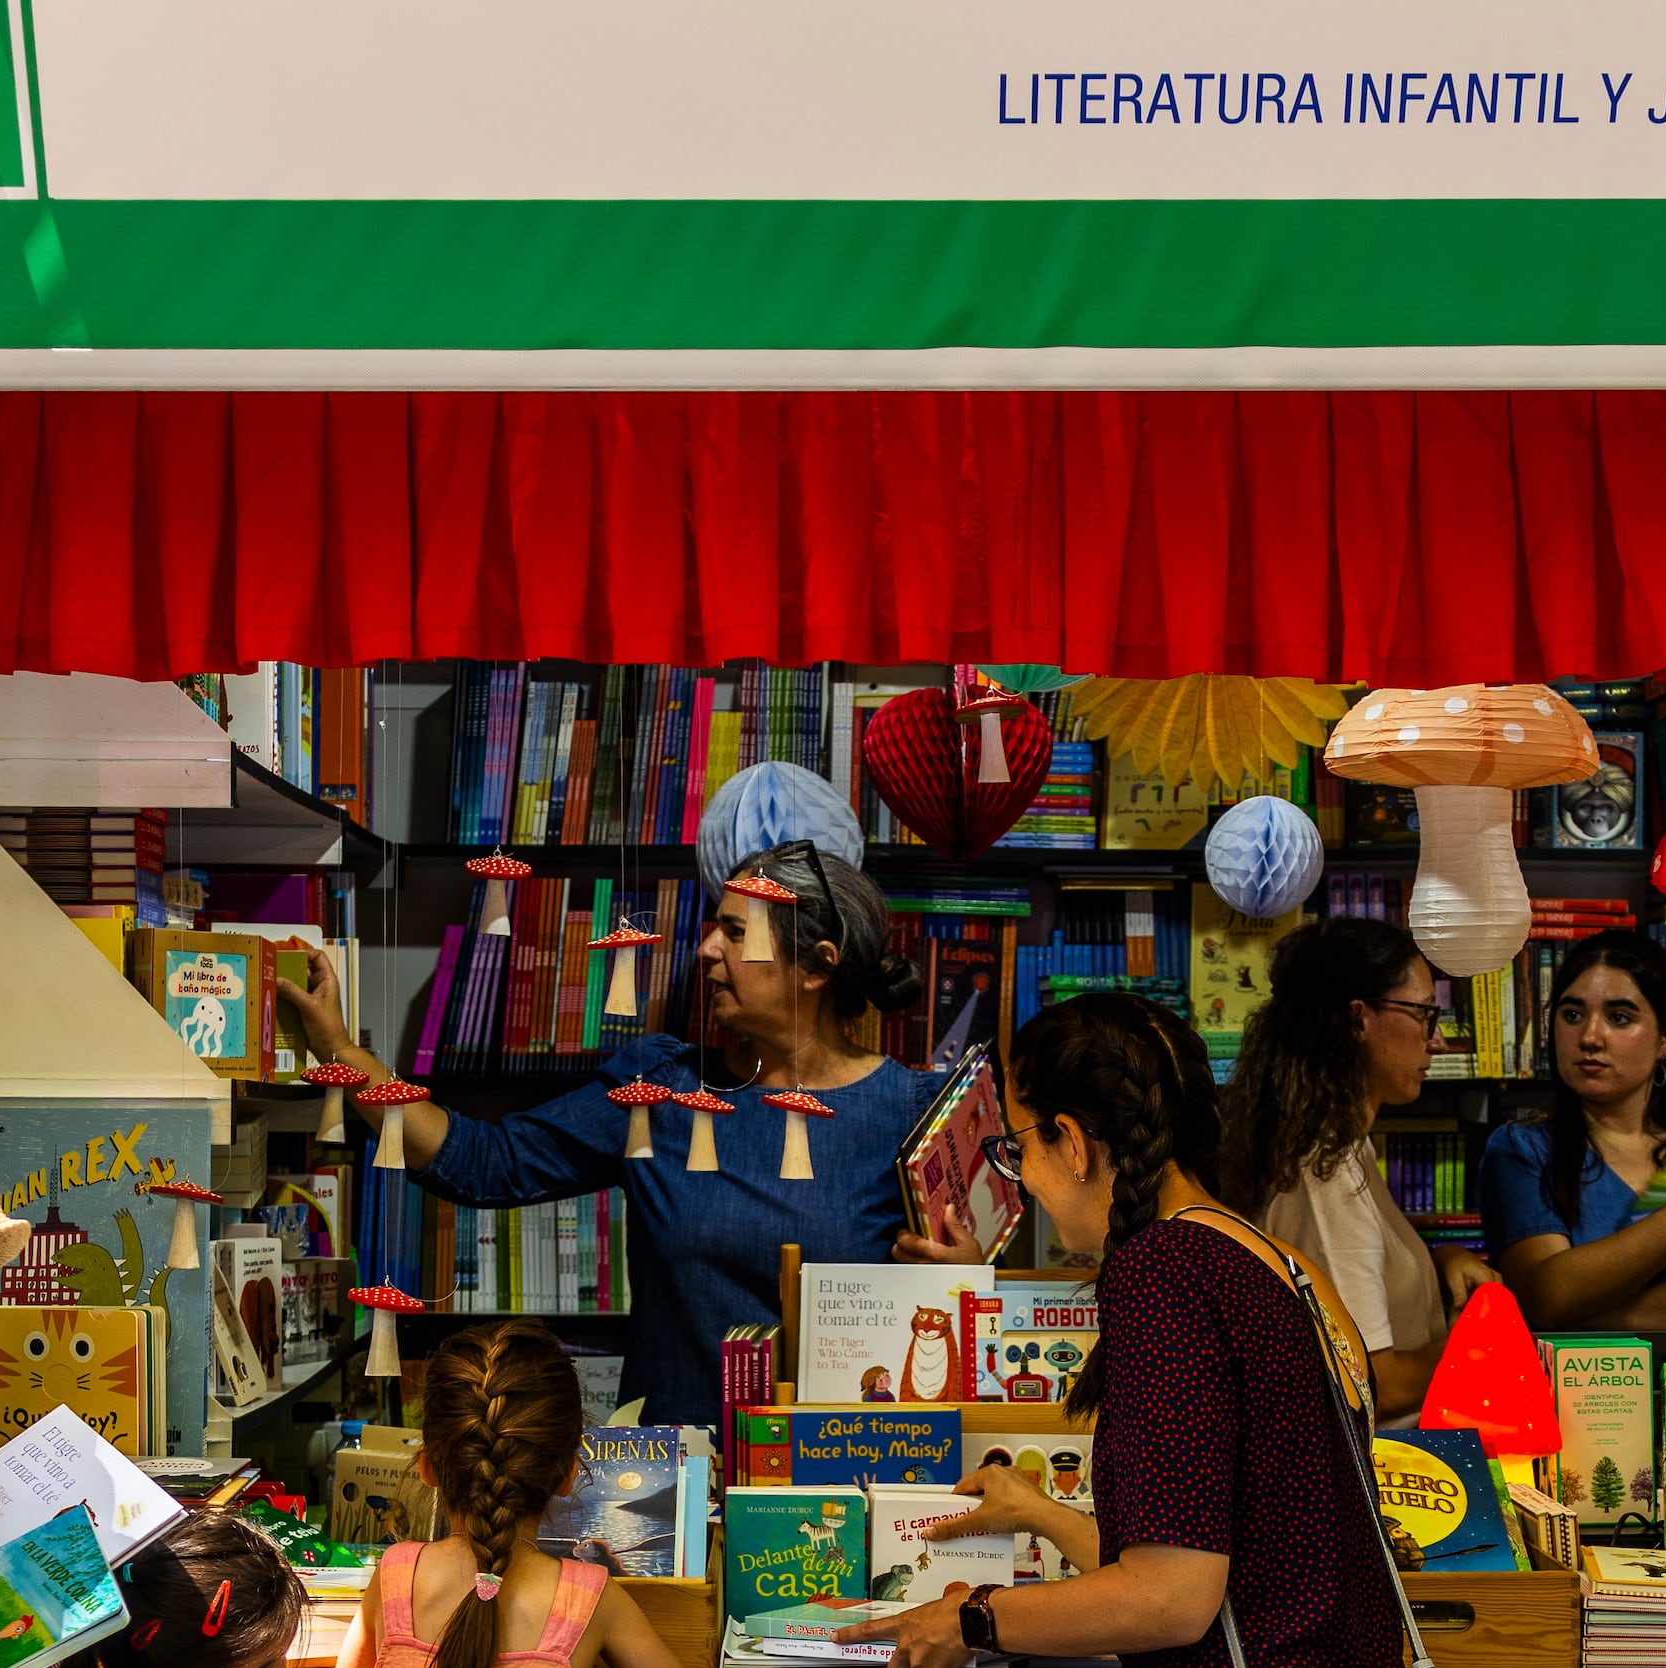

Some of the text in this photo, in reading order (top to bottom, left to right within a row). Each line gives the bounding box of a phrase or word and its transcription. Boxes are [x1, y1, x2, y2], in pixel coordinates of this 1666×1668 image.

[997, 73, 1324, 125] LITERATURA
[1342, 73, 1580, 125] INFANTIL
[1601, 73, 1638, 125] Y
[942, 946, 996, 964] Eclipses
[183, 971, 227, 982] Mi libro de
[178, 983, 232, 995] baño mágico
[59, 1123, 148, 1192] REX
[313, 1272, 338, 1285] PITO
[819, 1280, 871, 1298] El tigre
[818, 1295, 894, 1312] que vino a
[1033, 1297, 1041, 1305] Mi
[1043, 1297, 1074, 1307] primer
[818, 1312, 898, 1326] tomar el té
[818, 1337, 866, 1350] The Tiger
[818, 1349, 873, 1358] Who Came
[817, 1360, 849, 1369] to Tea
[1563, 1357, 1644, 1372] AVISTA
[1564, 1374, 1644, 1387] EL ÁRBOL
[818, 1416, 932, 1440] ¿Qué tiempo
[23, 1441, 47, 1462] que
[580, 1432, 668, 1461] SIRENAS
[799, 1439, 952, 1463] hace hoy, Maisy?
[355, 1466, 388, 1478] PELOS Y
[894, 1519, 906, 1531] El
[900, 1531, 914, 1542] de
[738, 1544, 812, 1573] Delante
[933, 1550, 1006, 1559] MARIANNE DUBUC
[803, 1552, 857, 1578] de mi
[40, 1556, 73, 1588] VERDE
[65, 1579, 103, 1614] COLINA
[755, 1572, 843, 1598] casa
[785, 1625, 828, 1636] EL PASTEL
[841, 1645, 877, 1658] agujero!
